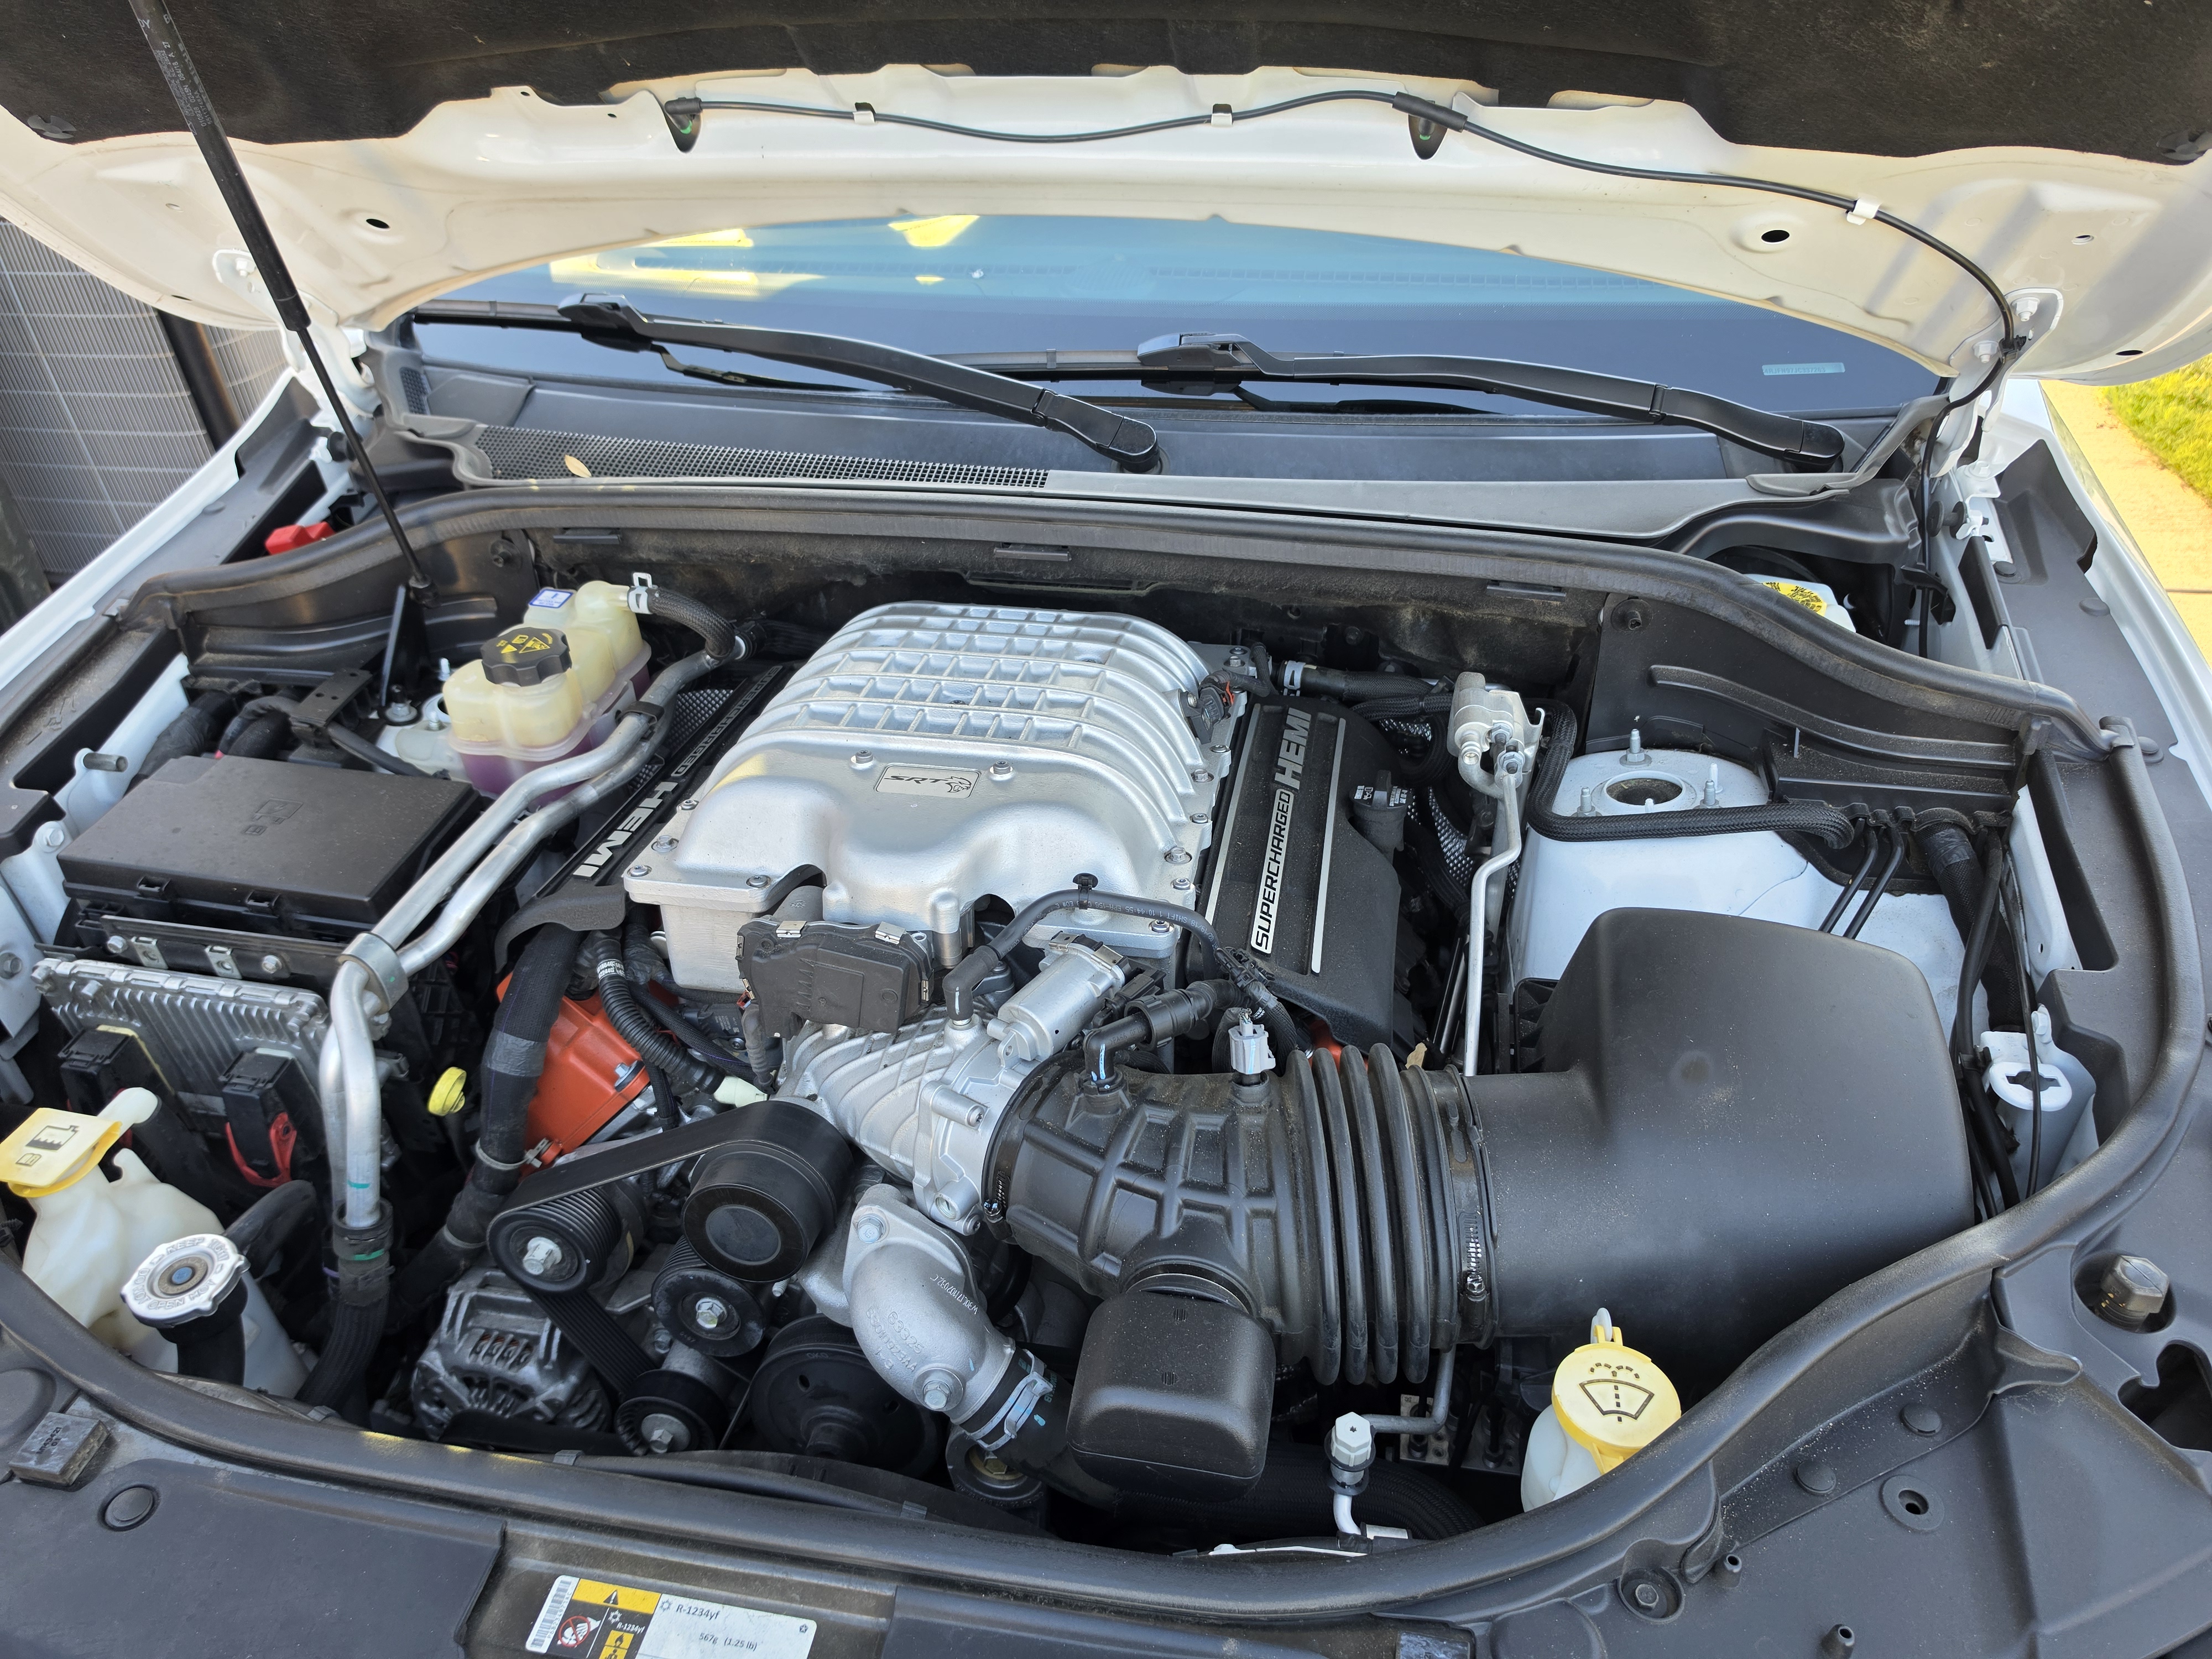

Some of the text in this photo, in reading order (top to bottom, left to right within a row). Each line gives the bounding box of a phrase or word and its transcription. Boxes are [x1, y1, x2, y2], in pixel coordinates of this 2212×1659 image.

[573, 666, 782, 878] SUPERCHARGED HEMI
[884, 775, 949, 784] SRT
[1256, 707, 1312, 950] SUPERCHARGED HEMI
[1125, 906, 1155, 916] 10:44:55
[166, 1237, 205, 1254] KEEP
[148, 1297, 185, 1310] OPEN
[888, 1311, 925, 1354] 63325
[676, 1604, 721, 1620] R-1234yf
[616, 1622, 646, 1635] R-1234yf
[699, 1632, 758, 1651] 567g (1.25 lb)
